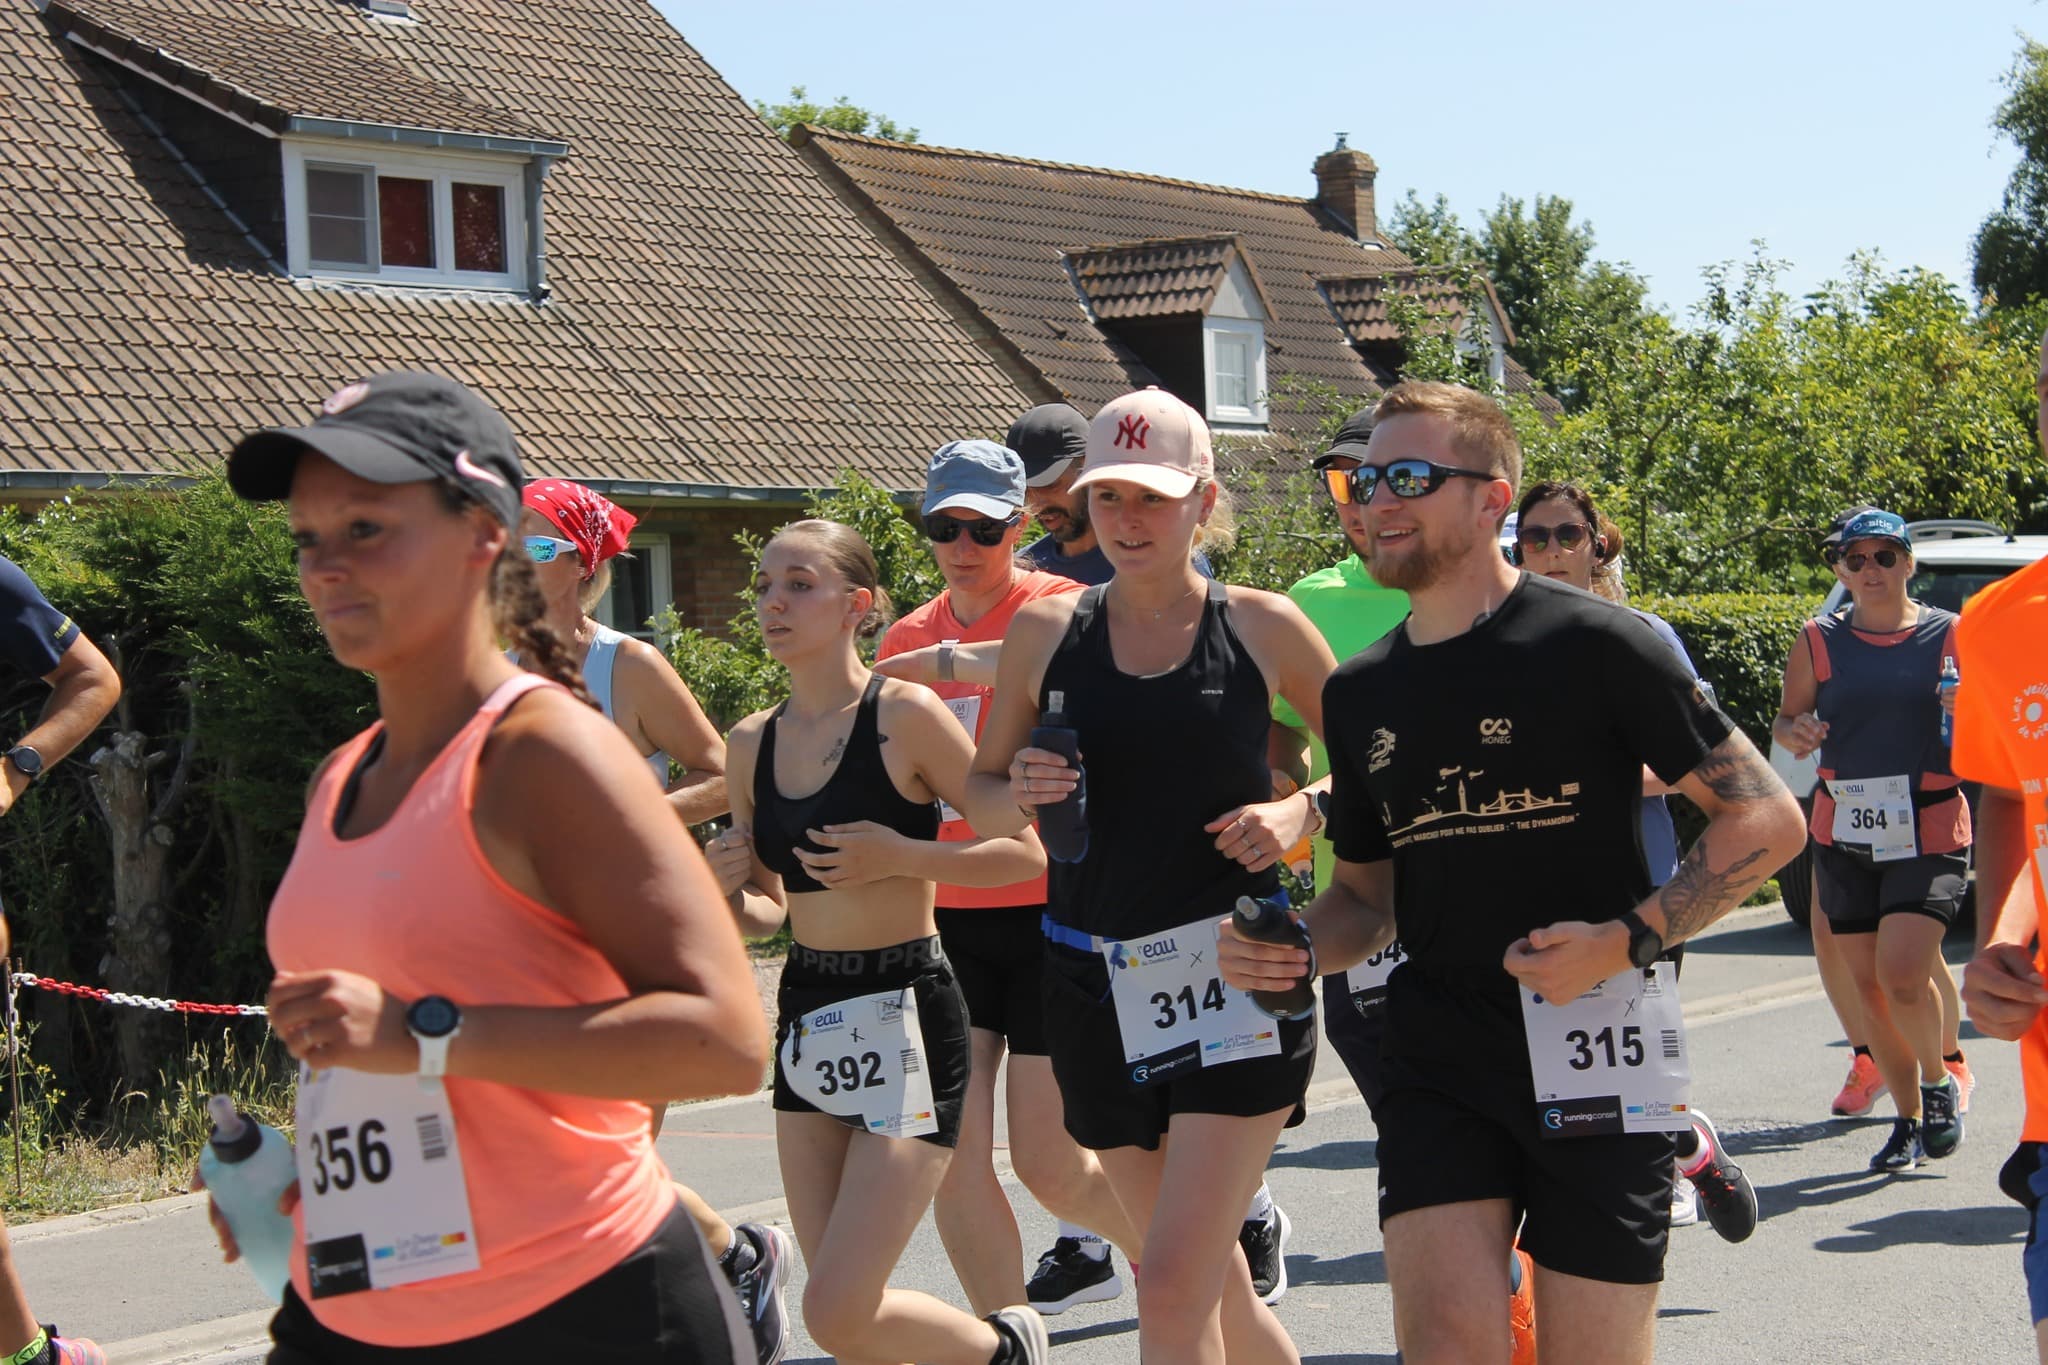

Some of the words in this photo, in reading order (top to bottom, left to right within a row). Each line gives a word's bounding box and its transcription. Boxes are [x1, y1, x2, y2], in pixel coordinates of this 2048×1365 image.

[1113, 413, 1151, 449] NY
[1851, 808, 1887, 830] 364
[1150, 977, 1226, 1029] 314
[1565, 1026, 1645, 1070] 315
[815, 1051, 886, 1096] 392
[311, 1119, 392, 1196] 356
